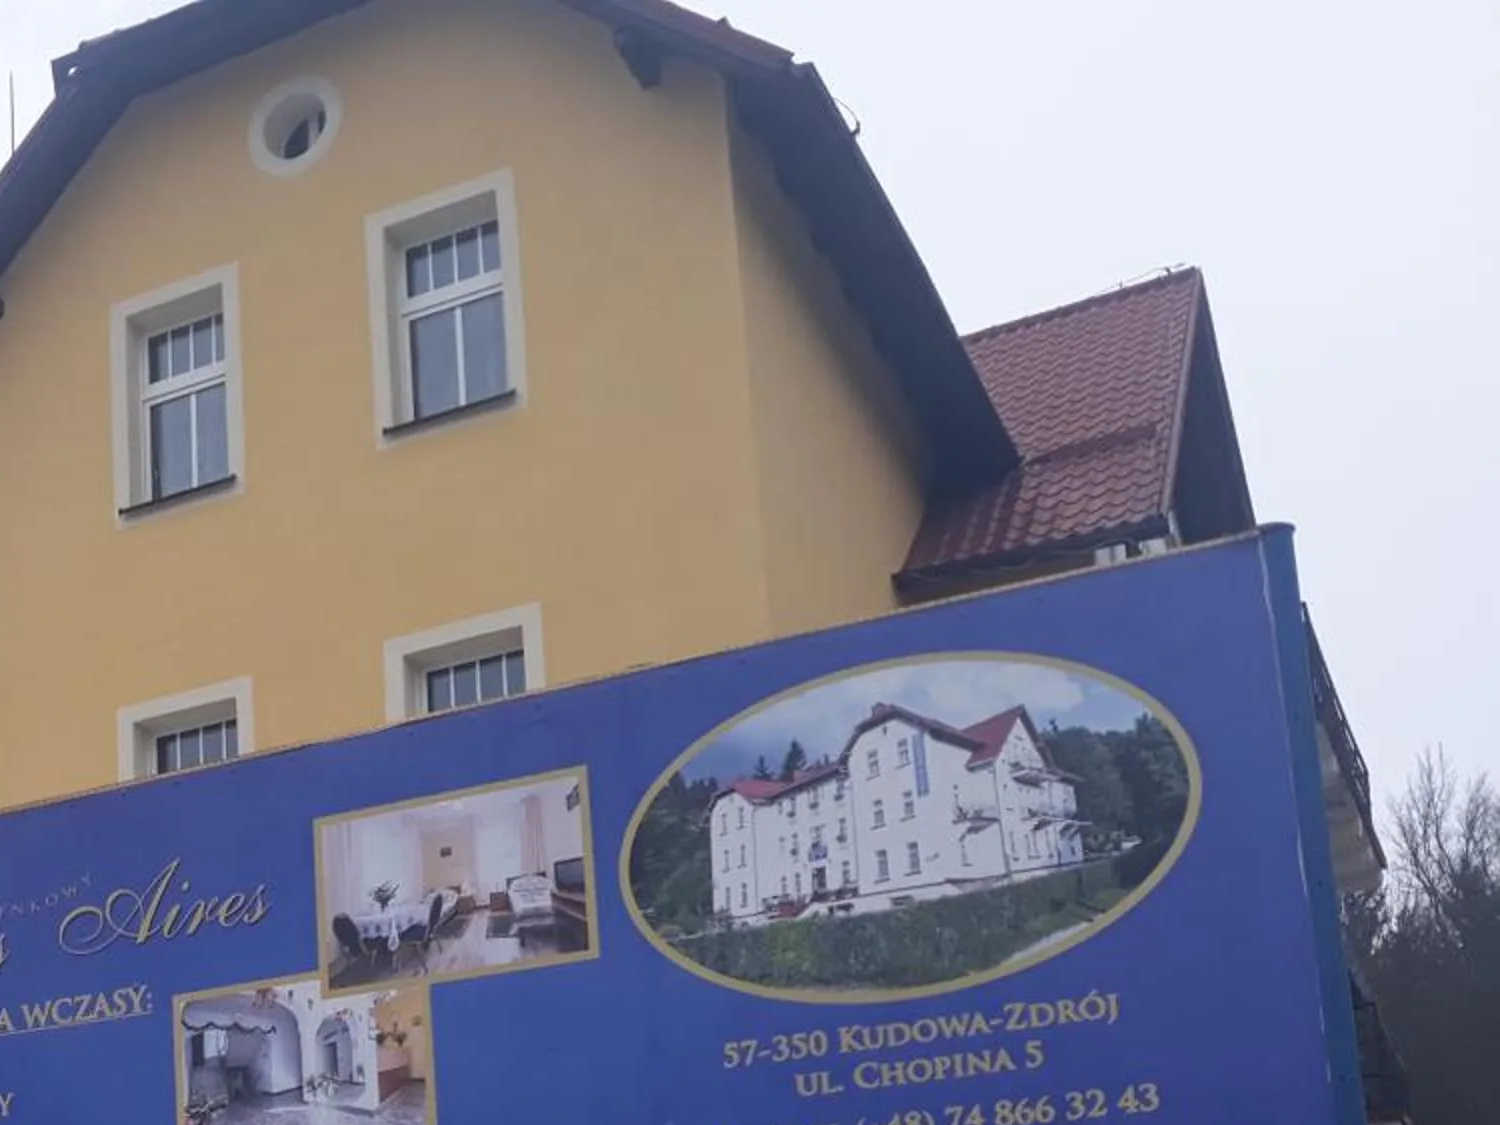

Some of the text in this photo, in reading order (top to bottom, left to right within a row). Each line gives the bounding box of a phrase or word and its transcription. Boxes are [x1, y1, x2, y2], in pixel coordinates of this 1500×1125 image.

[58, 856, 271, 955] Aires
[22, 985, 154, 1028] WCZASY:
[724, 989, 1121, 1069] 57-350 KUDOWA-ZDRÓJ
[795, 1040, 1045, 1098] UL. CHOPINA 5
[1065, 1089, 1106, 1122] 32
[1117, 1083, 1162, 1116] 43
